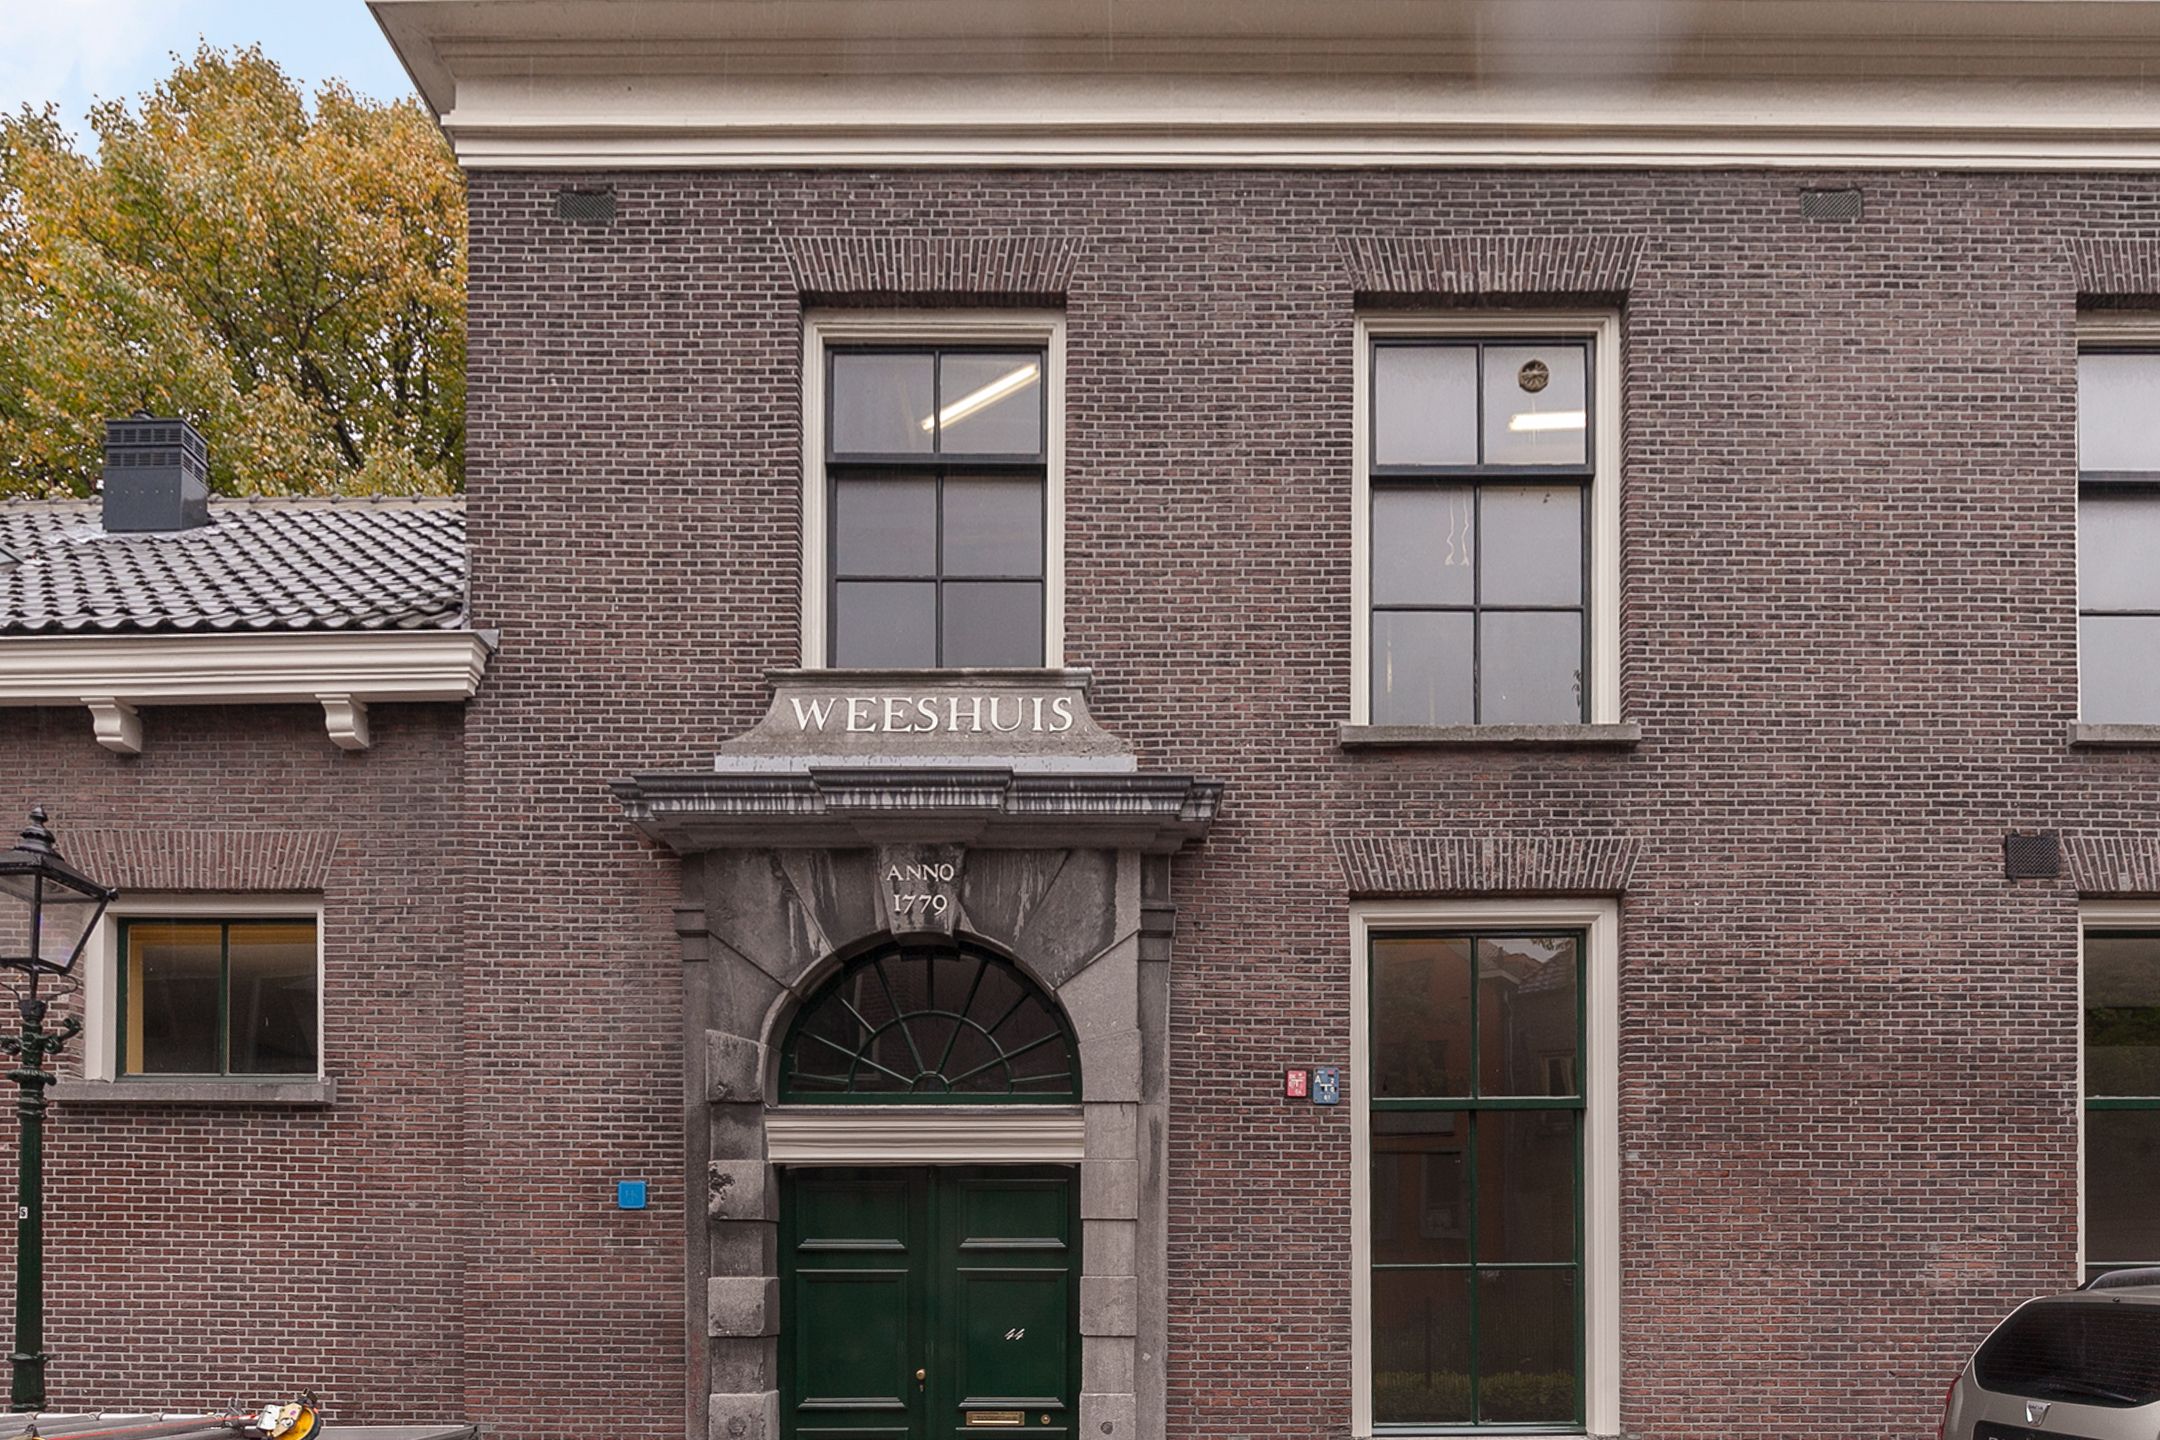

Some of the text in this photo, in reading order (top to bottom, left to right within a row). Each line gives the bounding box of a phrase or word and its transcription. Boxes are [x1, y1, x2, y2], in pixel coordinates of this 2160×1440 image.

[790, 696, 1074, 733] WEESHUIS
[886, 862, 955, 882] ANNO
[893, 893, 948, 916] 1779
